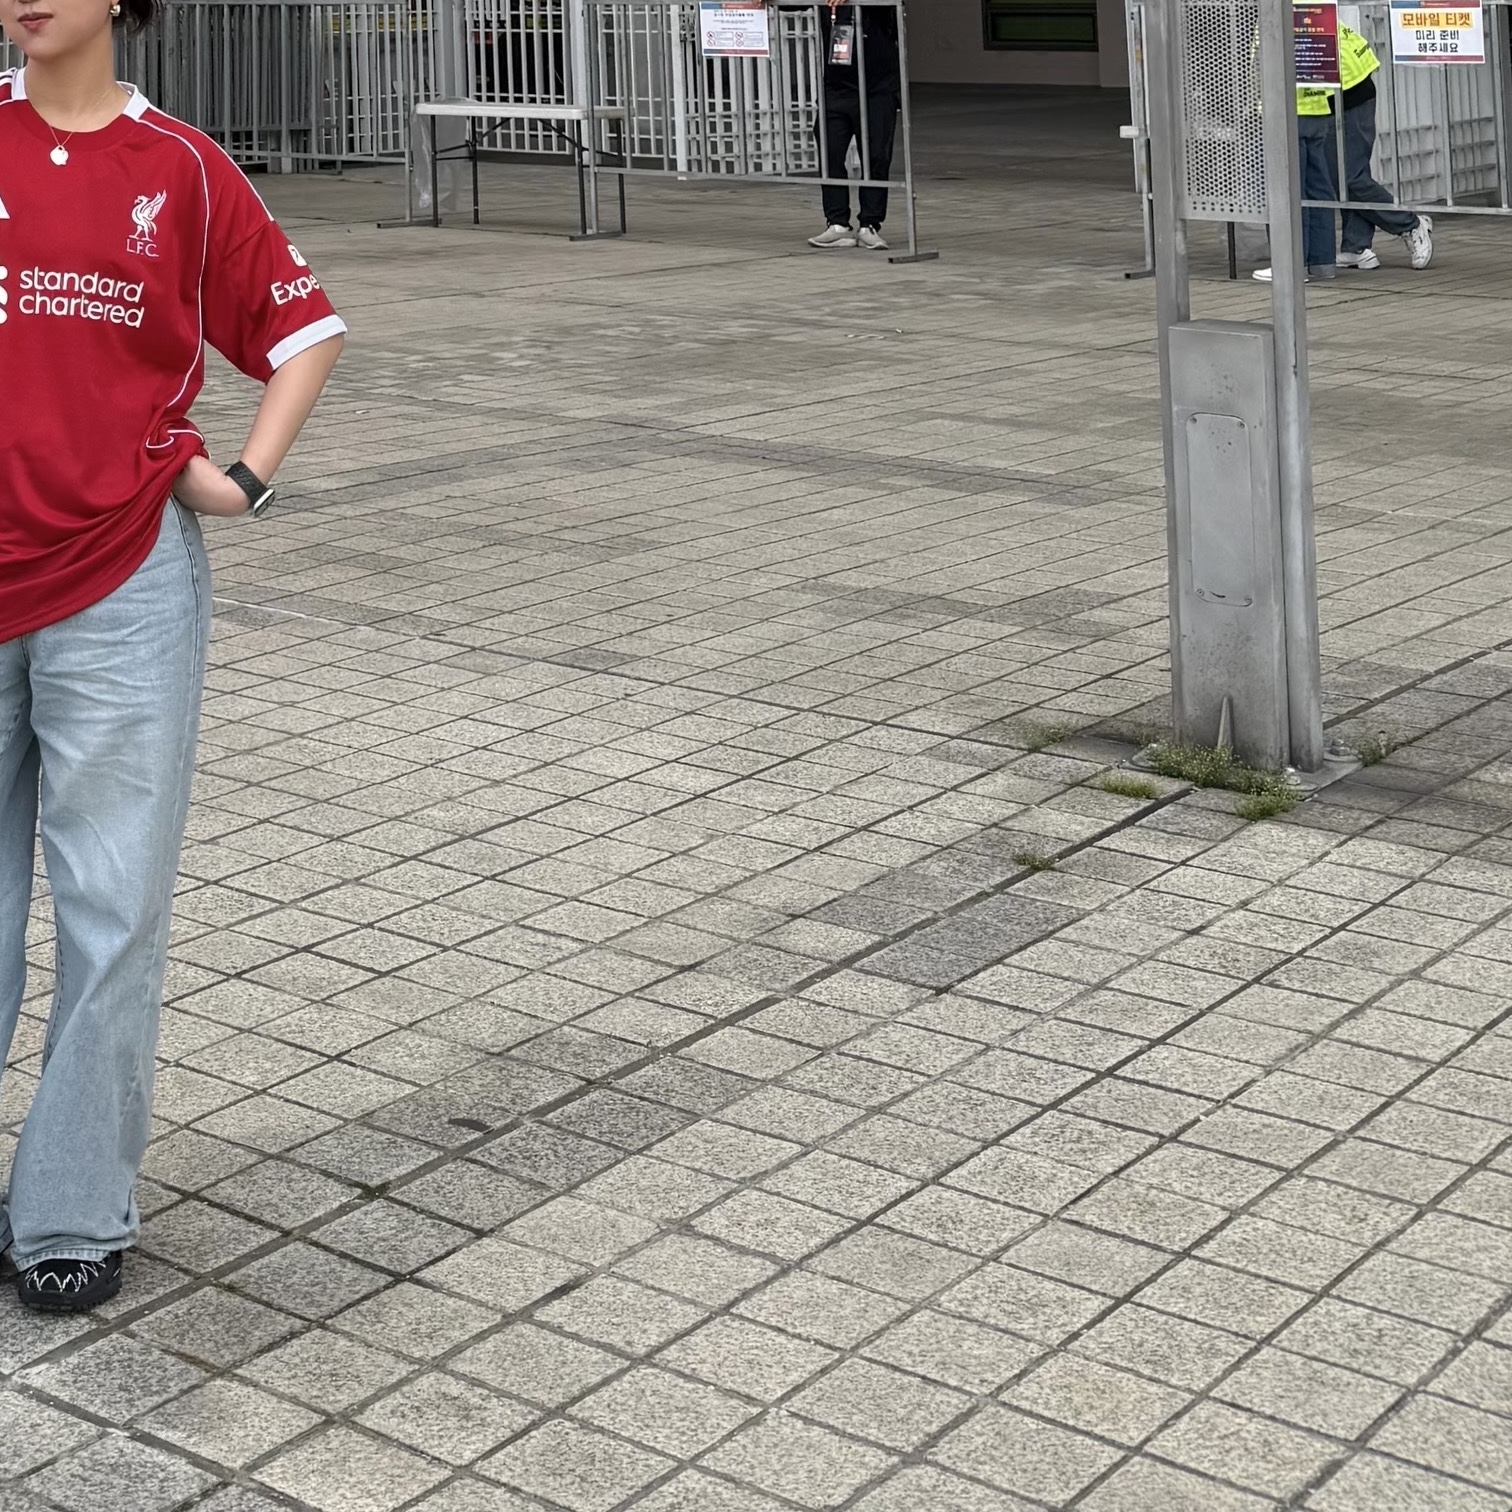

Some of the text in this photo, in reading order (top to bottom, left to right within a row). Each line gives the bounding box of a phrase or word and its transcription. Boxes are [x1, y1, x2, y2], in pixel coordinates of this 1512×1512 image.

[1402, 12, 1471, 27] 모바일 티켓
[1416, 30, 1460, 41] 미리 준비
[1418, 42, 1459, 53] 해주세요
[19, 266, 145, 303] standard
[18, 291, 145, 329] chartered
